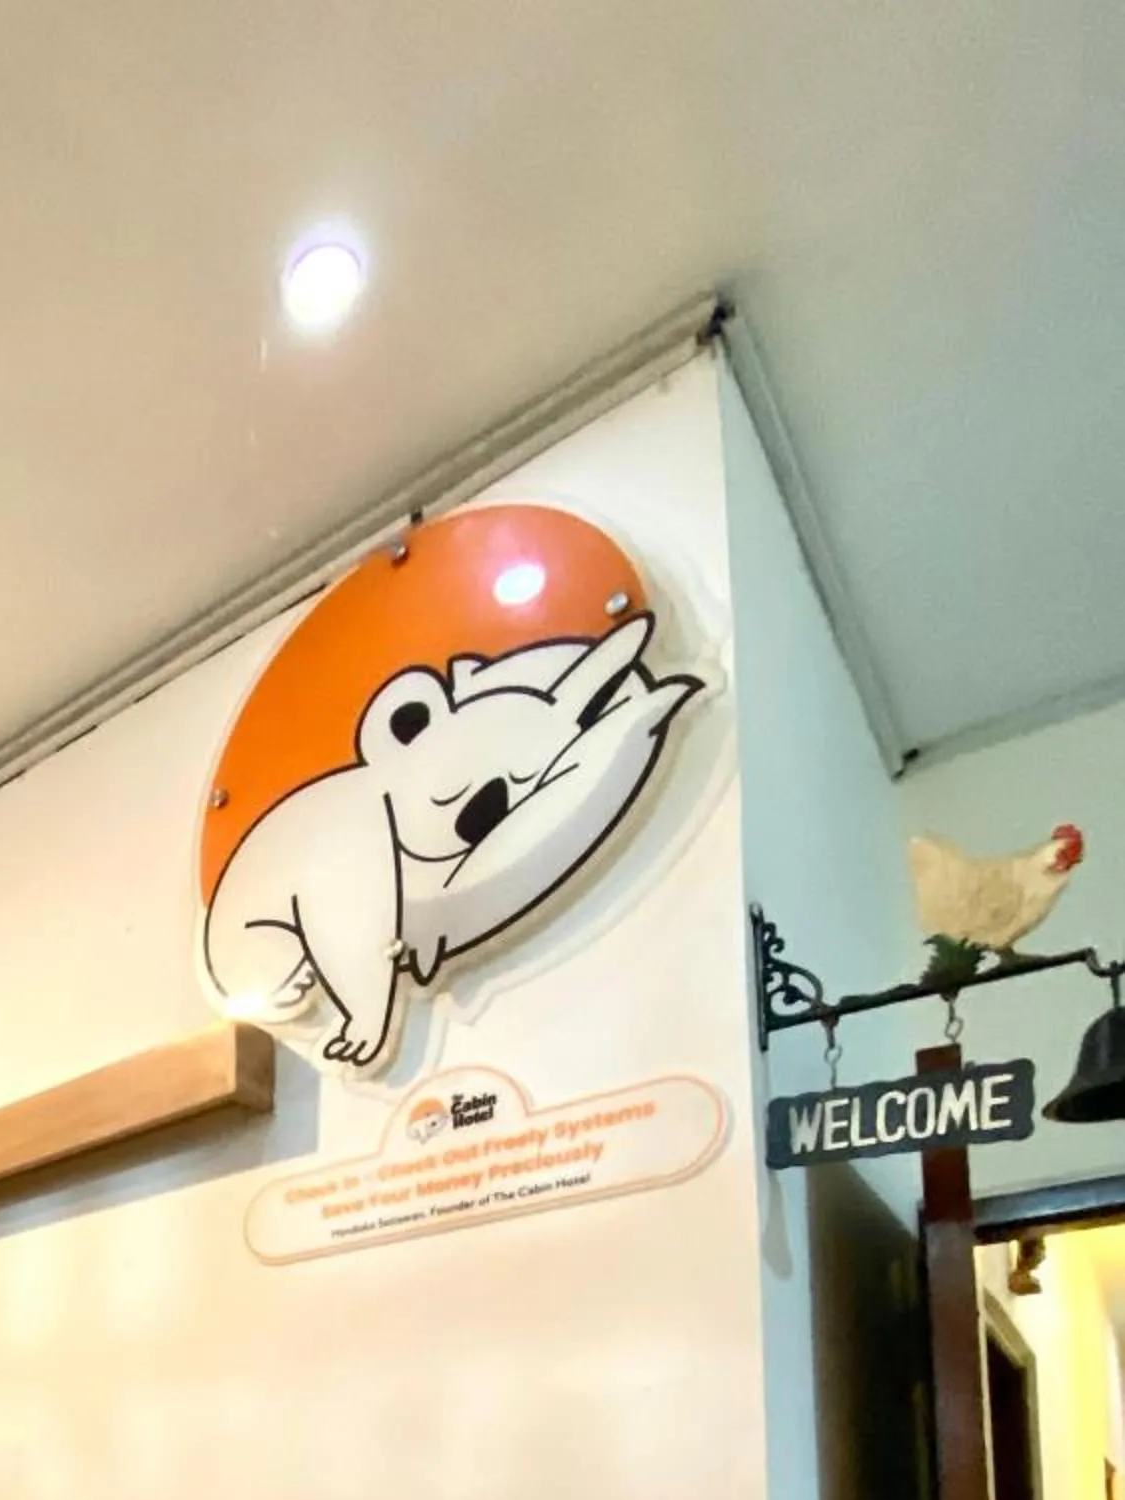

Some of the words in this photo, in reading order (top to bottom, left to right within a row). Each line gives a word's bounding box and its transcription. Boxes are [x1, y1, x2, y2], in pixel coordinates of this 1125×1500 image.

[451, 1092, 497, 1115] Cabin
[788, 1073, 1016, 1156] WELCOME
[453, 1105, 494, 1130] Hotel
[442, 1143, 479, 1165] Out
[417, 1171, 483, 1197] Money
[493, 1190, 515, 1202] The
[517, 1182, 553, 1198] Cabin
[555, 1173, 592, 1190] Hotel
